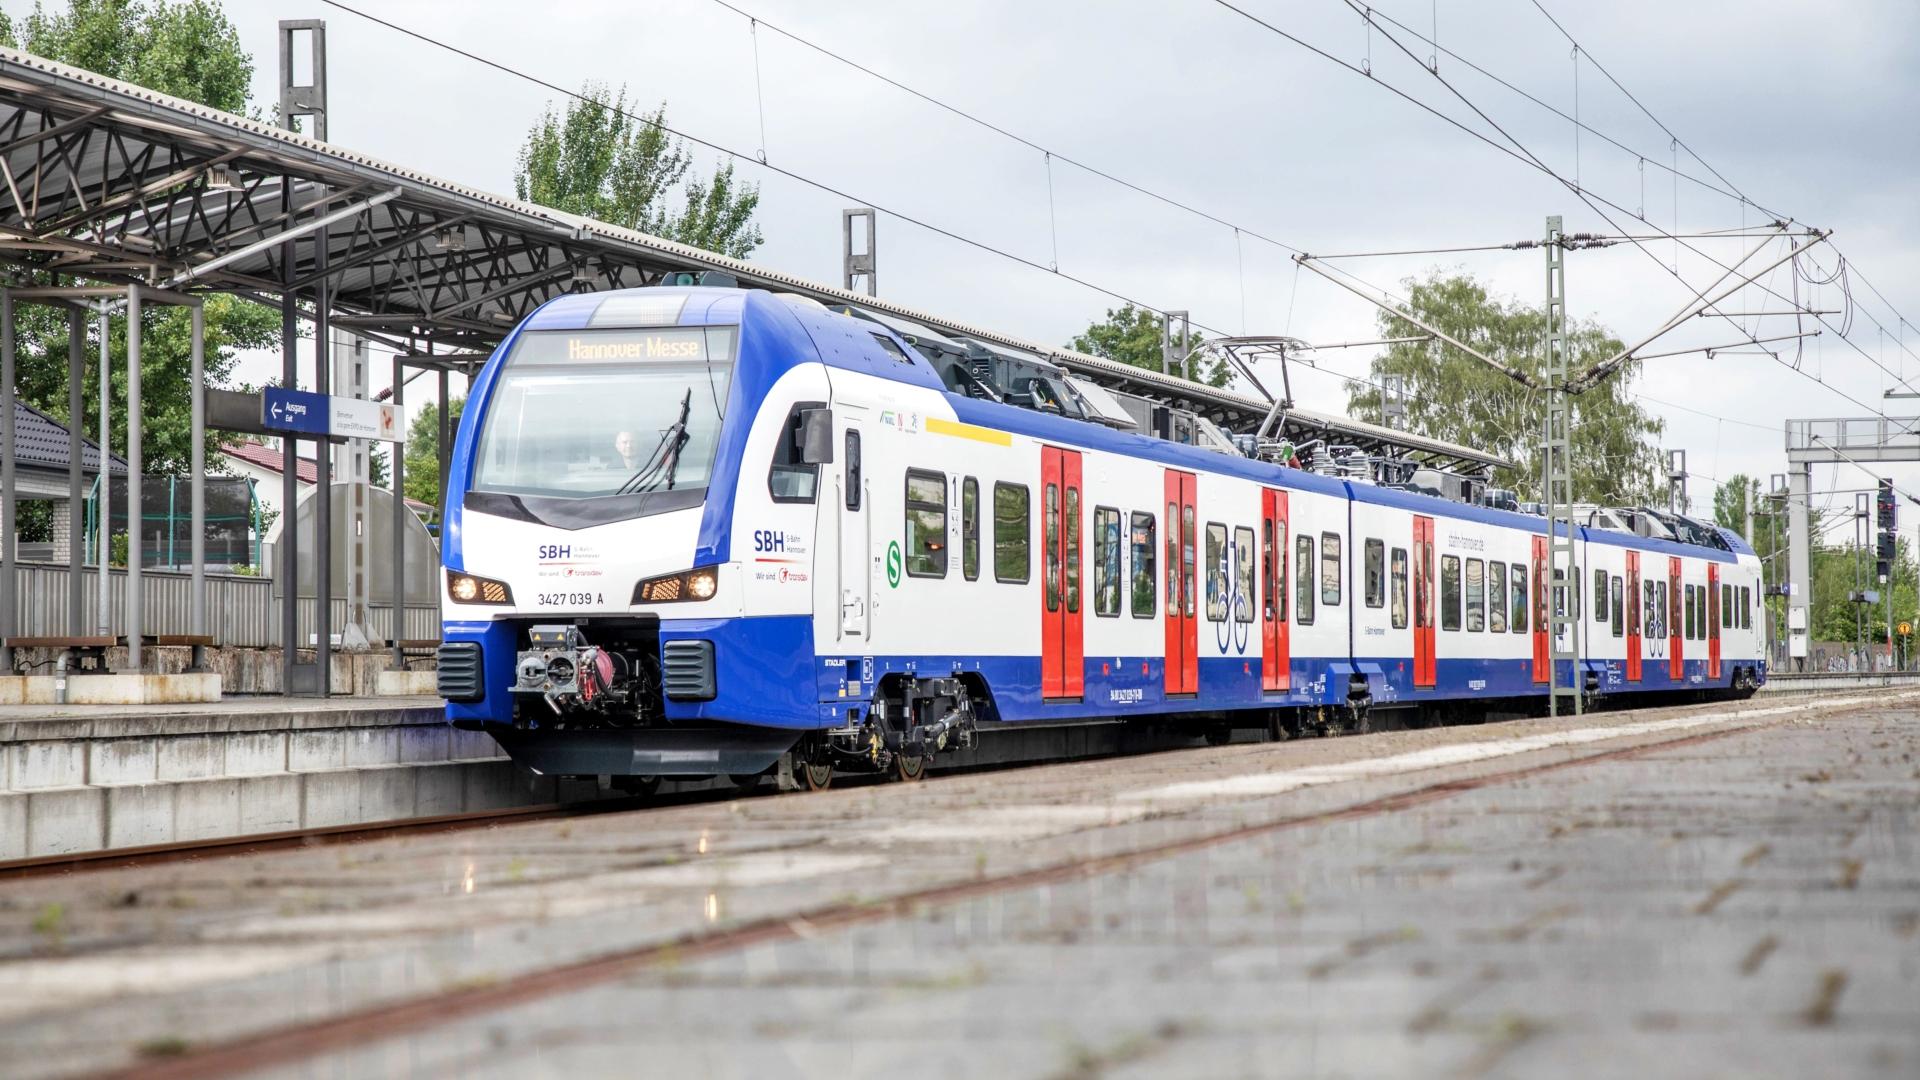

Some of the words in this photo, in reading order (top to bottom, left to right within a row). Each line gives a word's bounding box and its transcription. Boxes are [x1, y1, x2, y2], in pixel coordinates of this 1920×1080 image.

[569, 338, 642, 359] Hannover
[646, 337, 698, 357] Messe
[285, 401, 307, 415] Ausgang
[285, 414, 293, 423] Exit
[952, 475, 957, 508] 1
[1123, 511, 1128, 538] 2
[754, 530, 784, 552] SBH
[539, 544, 571, 559] SBH
[538, 593, 567, 605] 3427
[570, 593, 592, 605] 039
[597, 592, 603, 604] A
[824, 659, 846, 667] STADLER
